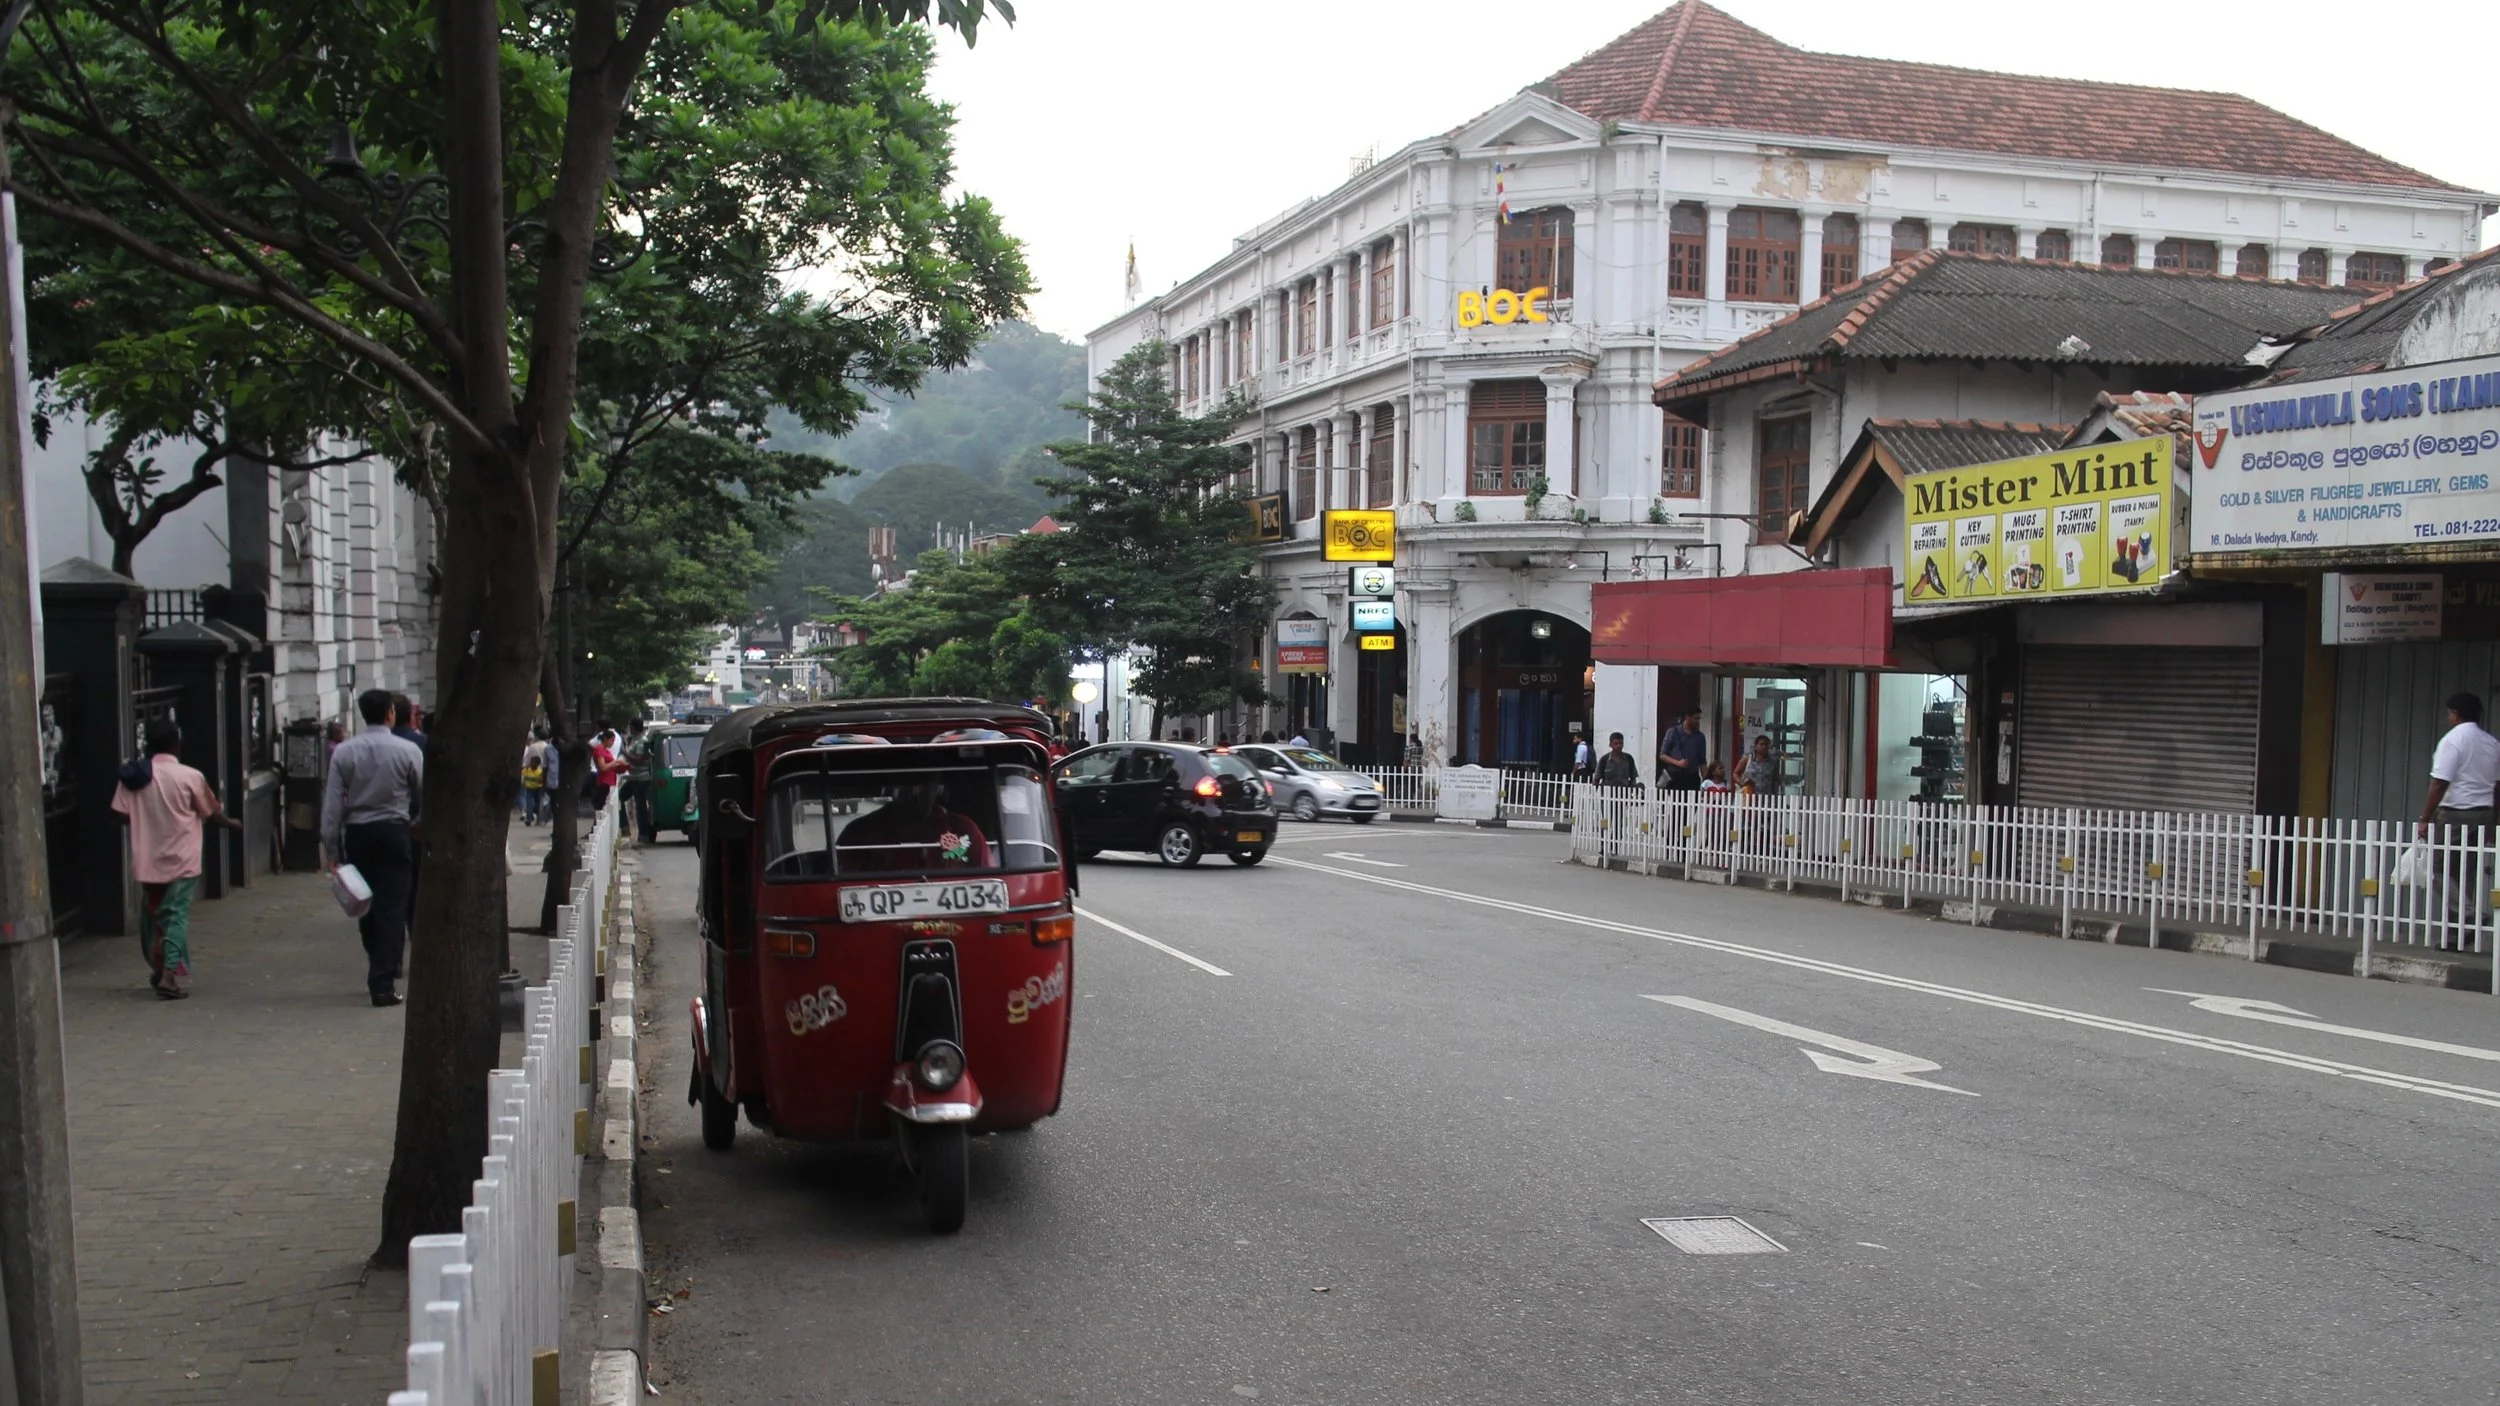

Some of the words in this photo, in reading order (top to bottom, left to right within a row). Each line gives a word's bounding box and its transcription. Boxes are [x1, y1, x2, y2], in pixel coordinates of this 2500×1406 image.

[1458, 286, 1549, 328] BOC
[2230, 390, 2355, 437] VISWAKULA
[2360, 382, 2423, 423] SONS
[1913, 475, 2038, 516] Mister
[2050, 451, 2159, 498] Mint
[2220, 491, 2250, 507] GOLD
[2253, 491, 2262, 504] &
[2265, 488, 2305, 504] SILVER
[2310, 484, 2364, 501] FILIGREE
[2367, 478, 2441, 498] JEWELLERY,
[2449, 474, 2489, 491] GEMS
[2060, 507, 2094, 522] T-SHIRT
[2111, 502, 2132, 514] RUBBER
[2297, 509, 2306, 523] &
[2313, 503, 2402, 522] HANDICRAFTS
[1263, 506, 1279, 528] BOC
[2012, 514, 2037, 527] MUGS
[2123, 516, 2145, 528] STAMPS
[1921, 524, 1938, 538] SHOE
[1967, 520, 1982, 533] KEY
[2056, 520, 2097, 537] PRINTING
[1334, 525, 1385, 547] BOC
[1960, 533, 1991, 547] CUTTING
[2005, 527, 2045, 542] PRINTING
[2224, 532, 2253, 546] Dalada
[2290, 531, 2319, 545] Kandy.
[1914, 537, 1948, 551] REPAIRING
[1368, 638, 1389, 647] ATM
[1748, 716, 1762, 728] FILA
[870, 890, 905, 916] QP
[936, 884, 1003, 911] 4034
[844, 901, 866, 918] CP
